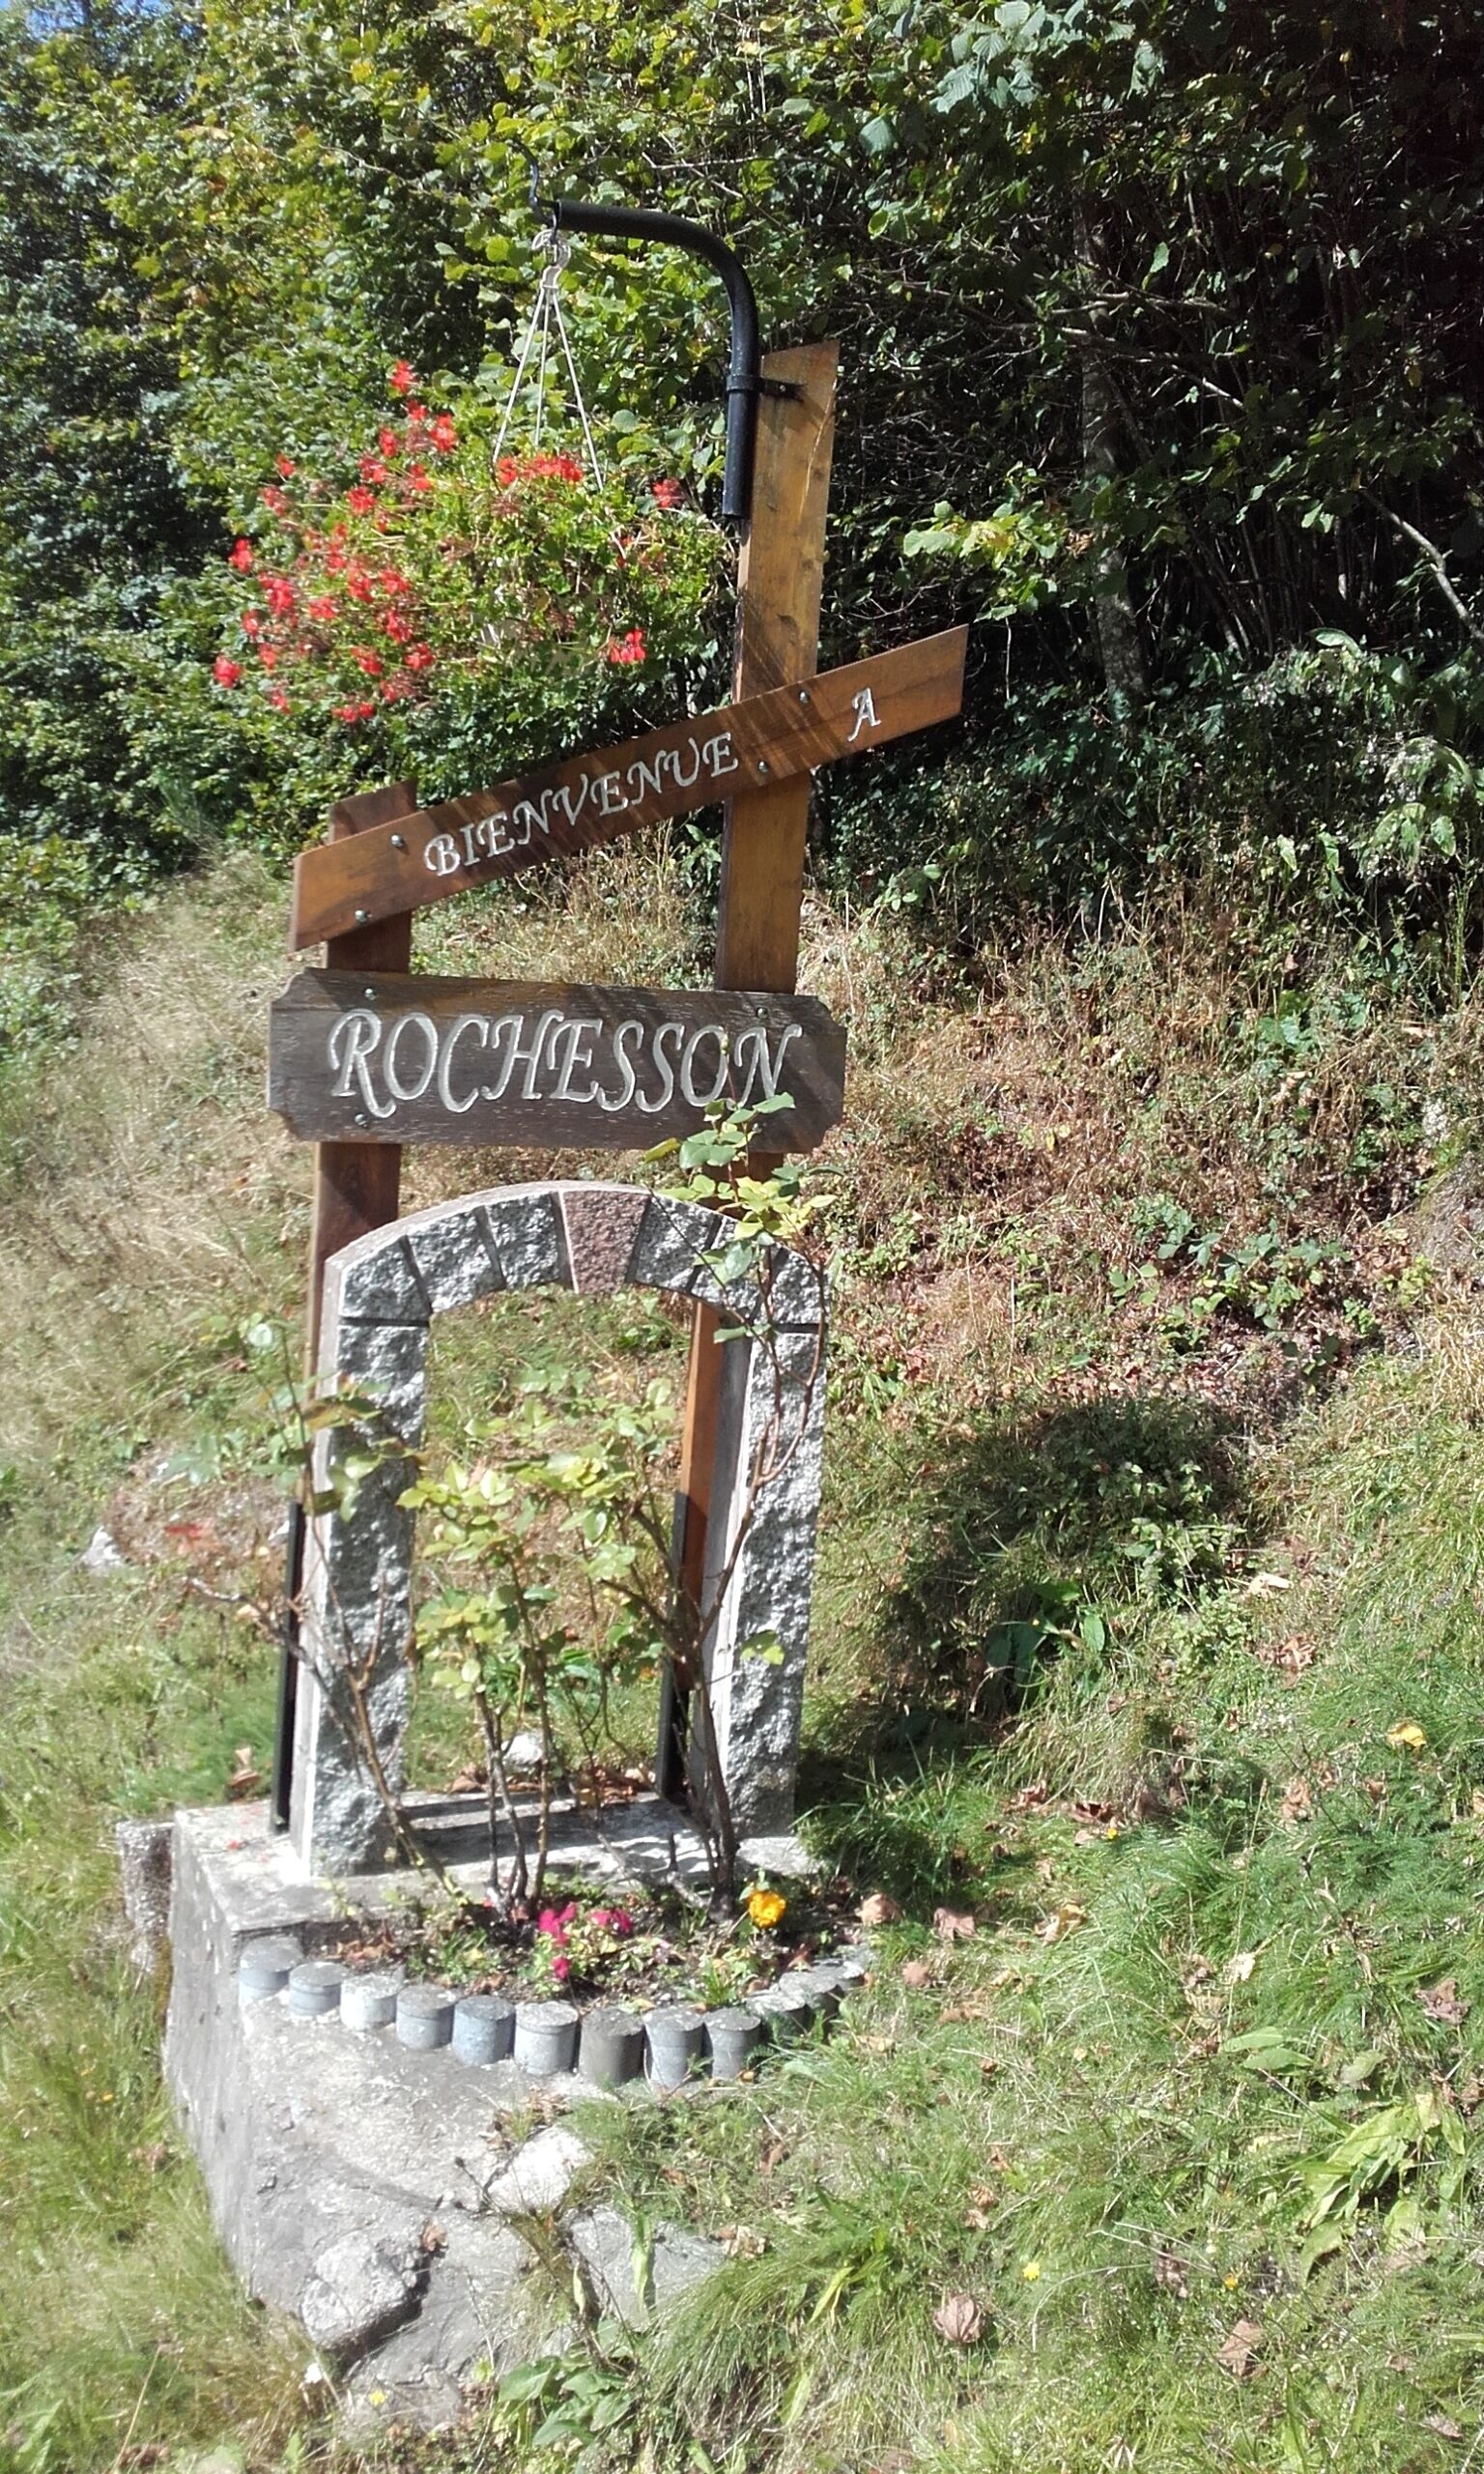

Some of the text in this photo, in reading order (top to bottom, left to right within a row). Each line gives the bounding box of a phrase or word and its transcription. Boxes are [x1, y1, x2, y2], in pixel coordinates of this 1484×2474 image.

[424, 687, 882, 876] BIENVENUE A
[328, 1008, 802, 1118] ROCHESSON
